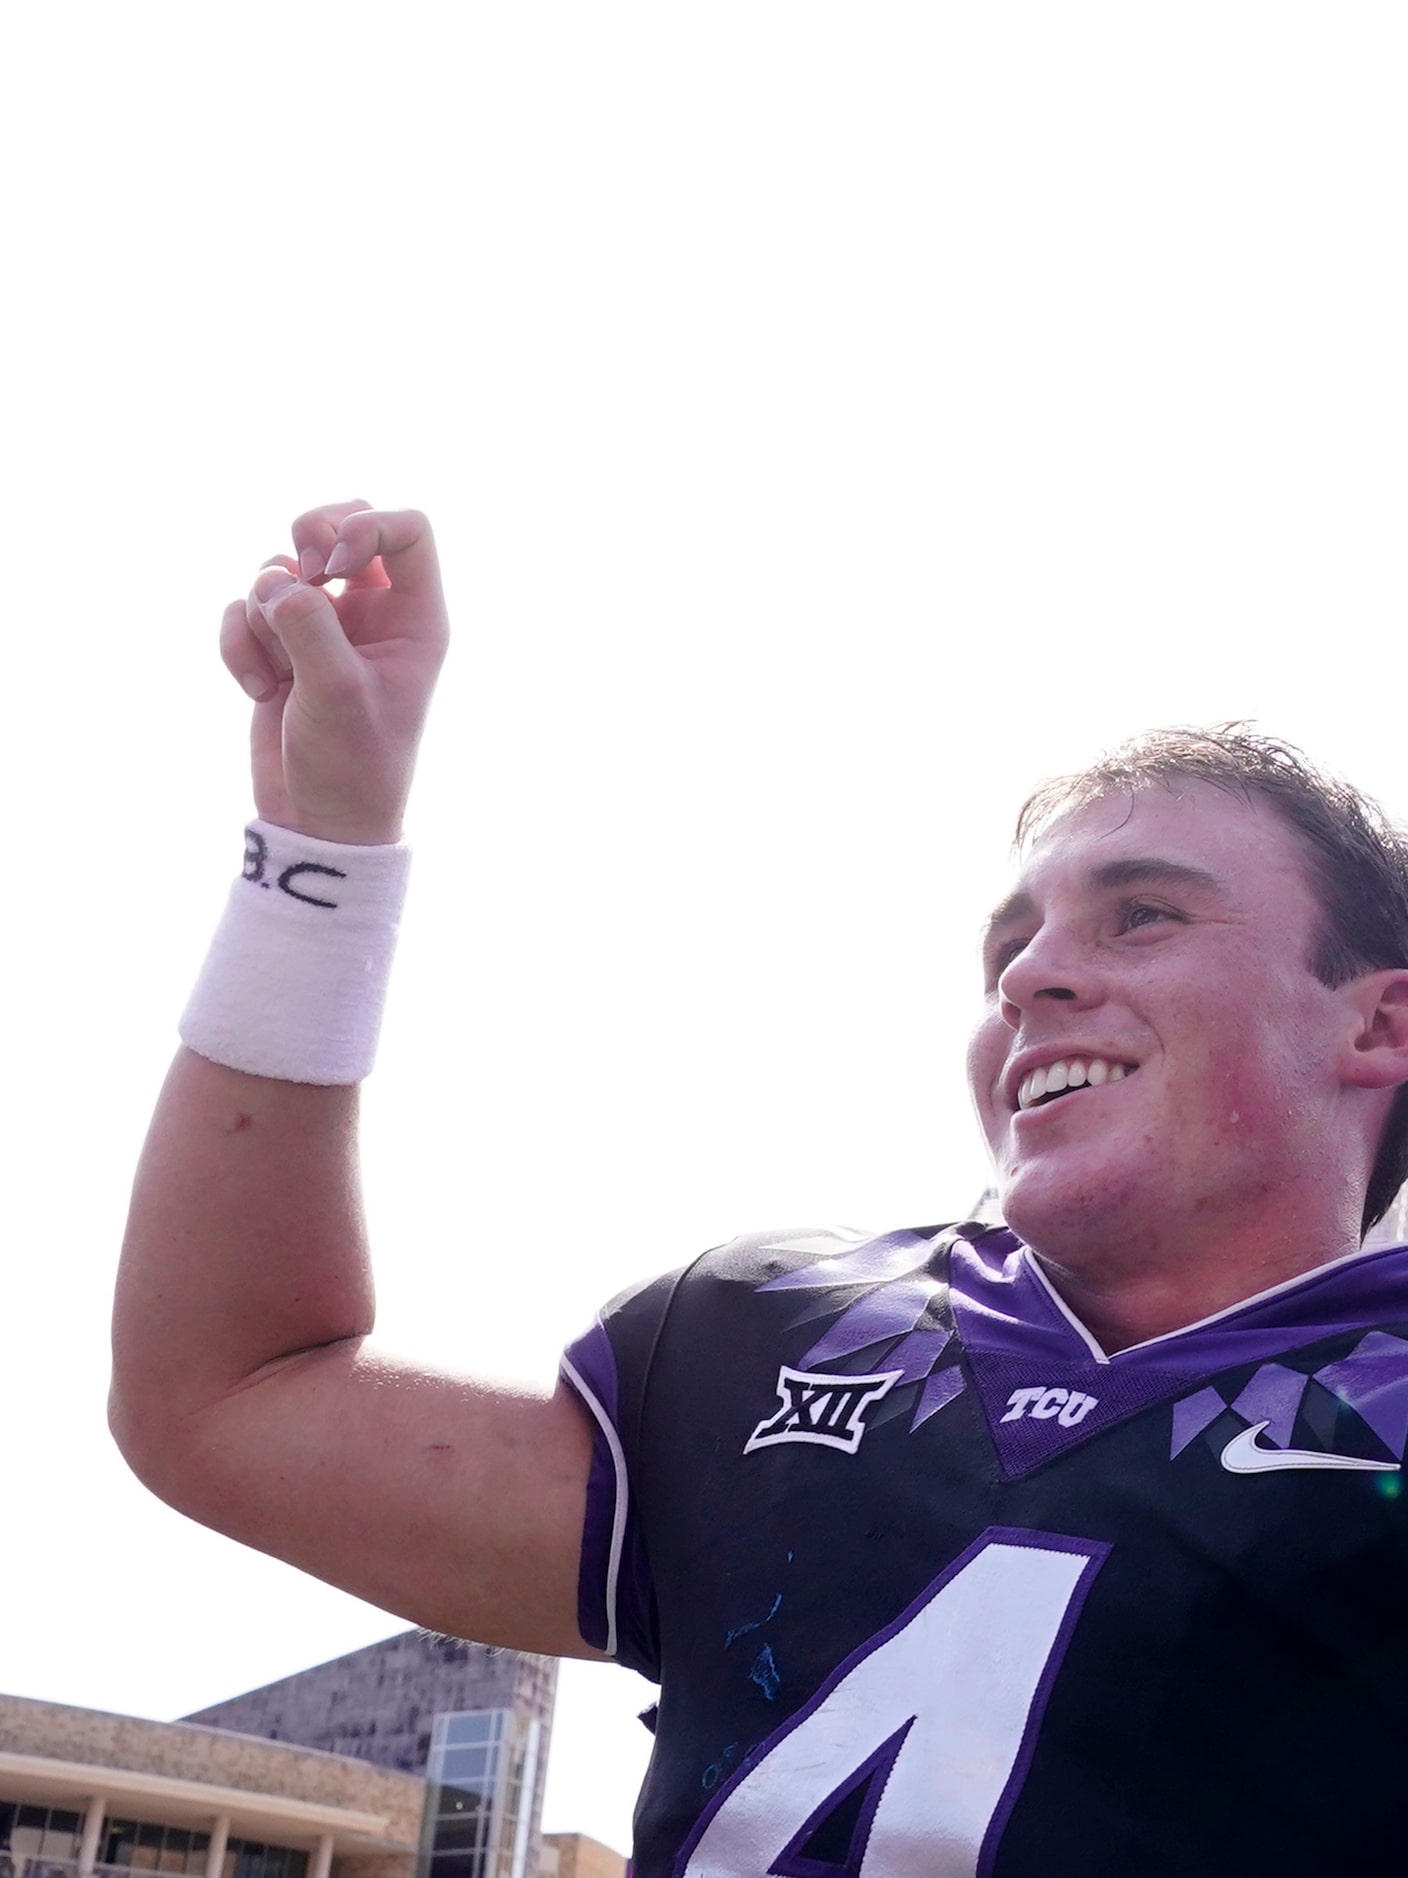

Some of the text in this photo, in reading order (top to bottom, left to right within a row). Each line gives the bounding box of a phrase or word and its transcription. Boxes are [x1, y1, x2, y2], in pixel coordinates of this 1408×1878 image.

[748, 1372, 897, 1447] XII
[1000, 1386, 1099, 1427] TCU
[674, 1527, 1112, 1878] 4
